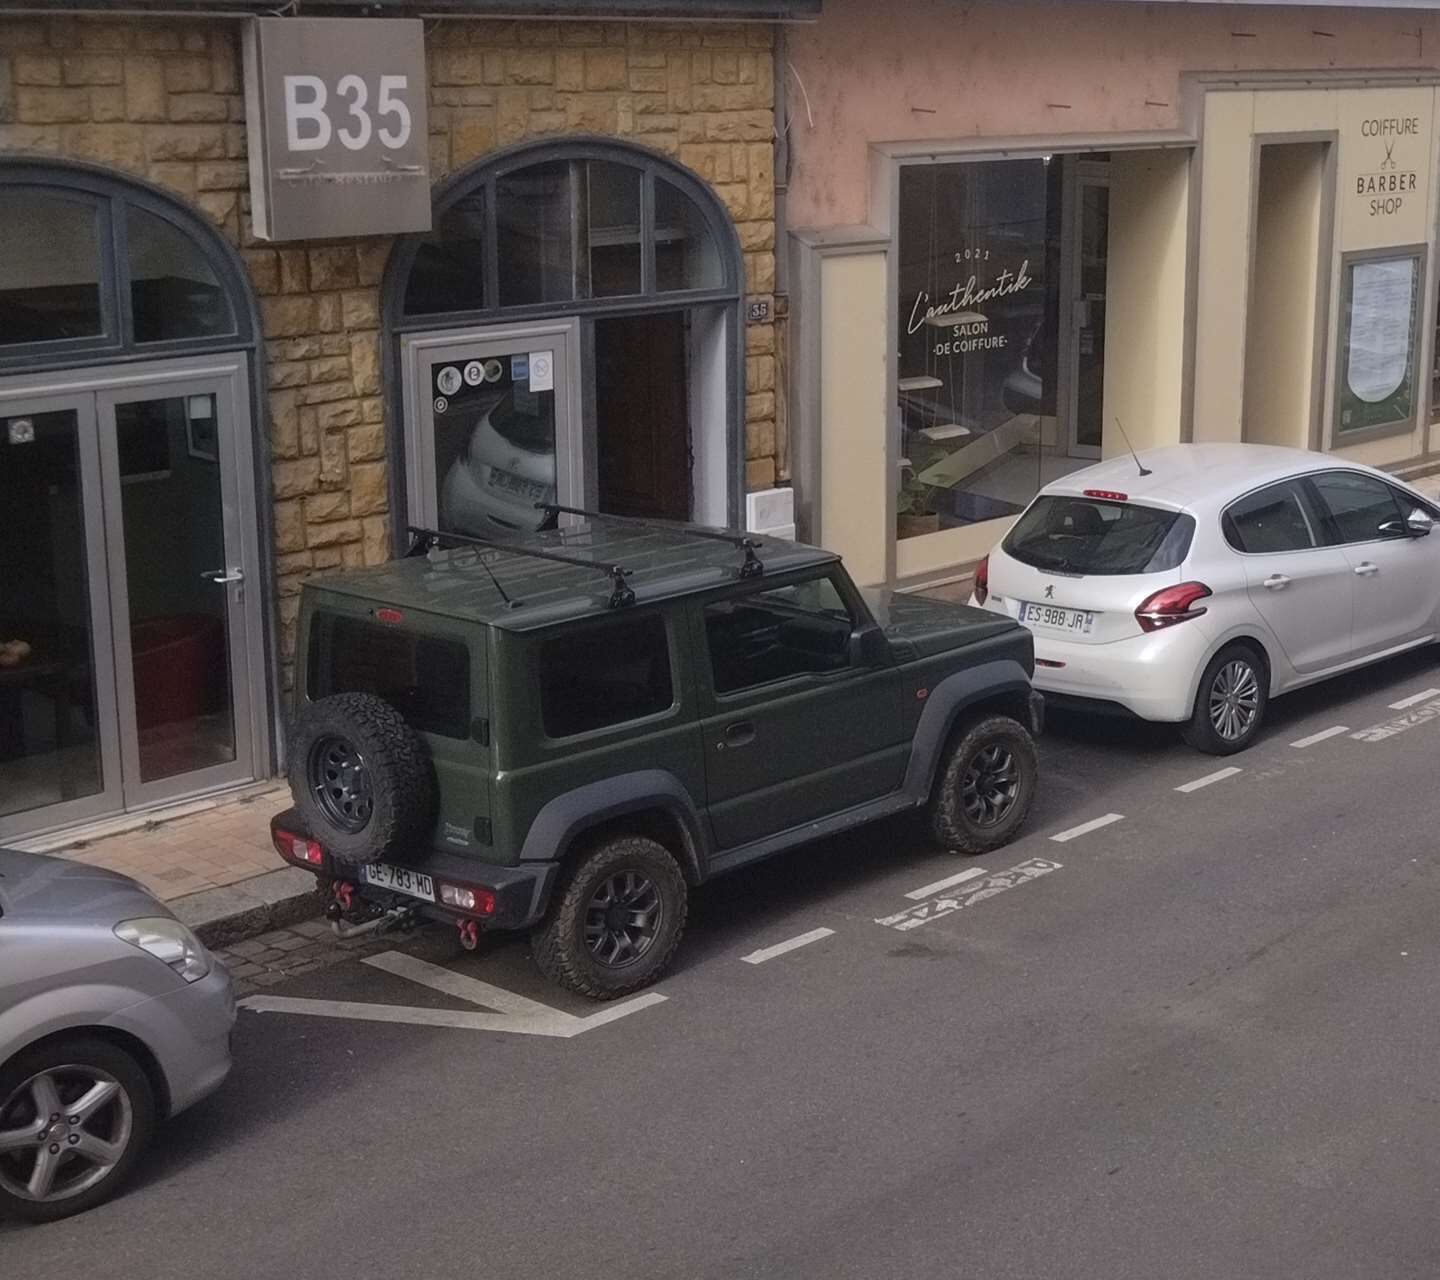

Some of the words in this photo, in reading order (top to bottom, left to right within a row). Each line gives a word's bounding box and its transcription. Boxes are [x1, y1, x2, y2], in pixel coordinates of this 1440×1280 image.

[284, 74, 412, 152] B35
[1361, 118, 1419, 136] COIFFURE
[1357, 173, 1417, 194] BARBER
[1369, 197, 1403, 216] SHOP
[955, 248, 990, 263] 2021
[953, 322, 988, 338] SALON
[952, 335, 1006, 354] COIFFURE
